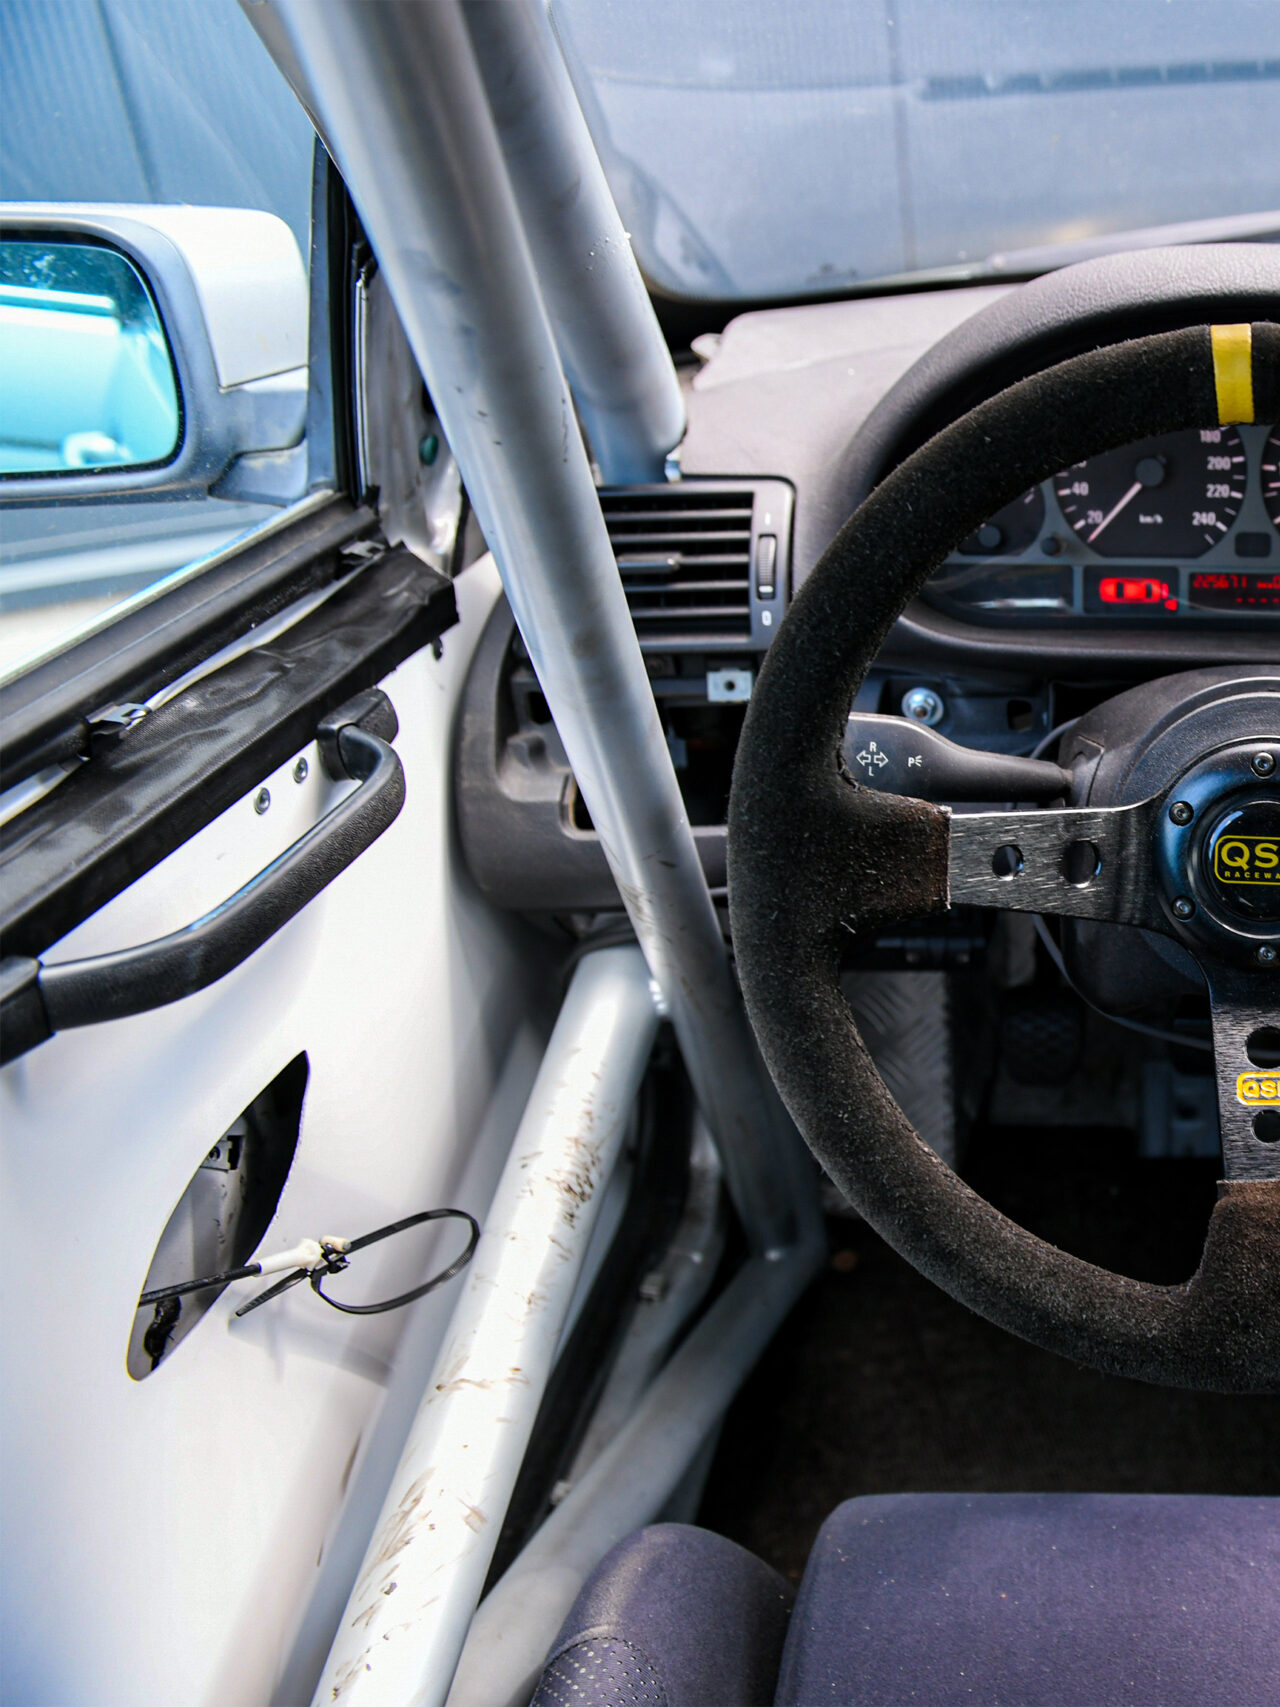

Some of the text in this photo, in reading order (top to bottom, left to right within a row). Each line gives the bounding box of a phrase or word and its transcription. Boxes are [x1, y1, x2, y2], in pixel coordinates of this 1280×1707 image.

[1207, 456, 1231, 470] 200
[1072, 482, 1089, 496] 40
[1206, 484, 1230, 498] 220
[1087, 510, 1103, 525] 20
[1139, 514, 1163, 524] km/h
[1192, 512, 1217, 526] 240
[869, 741, 877, 752] R
[868, 766, 874, 776] L
